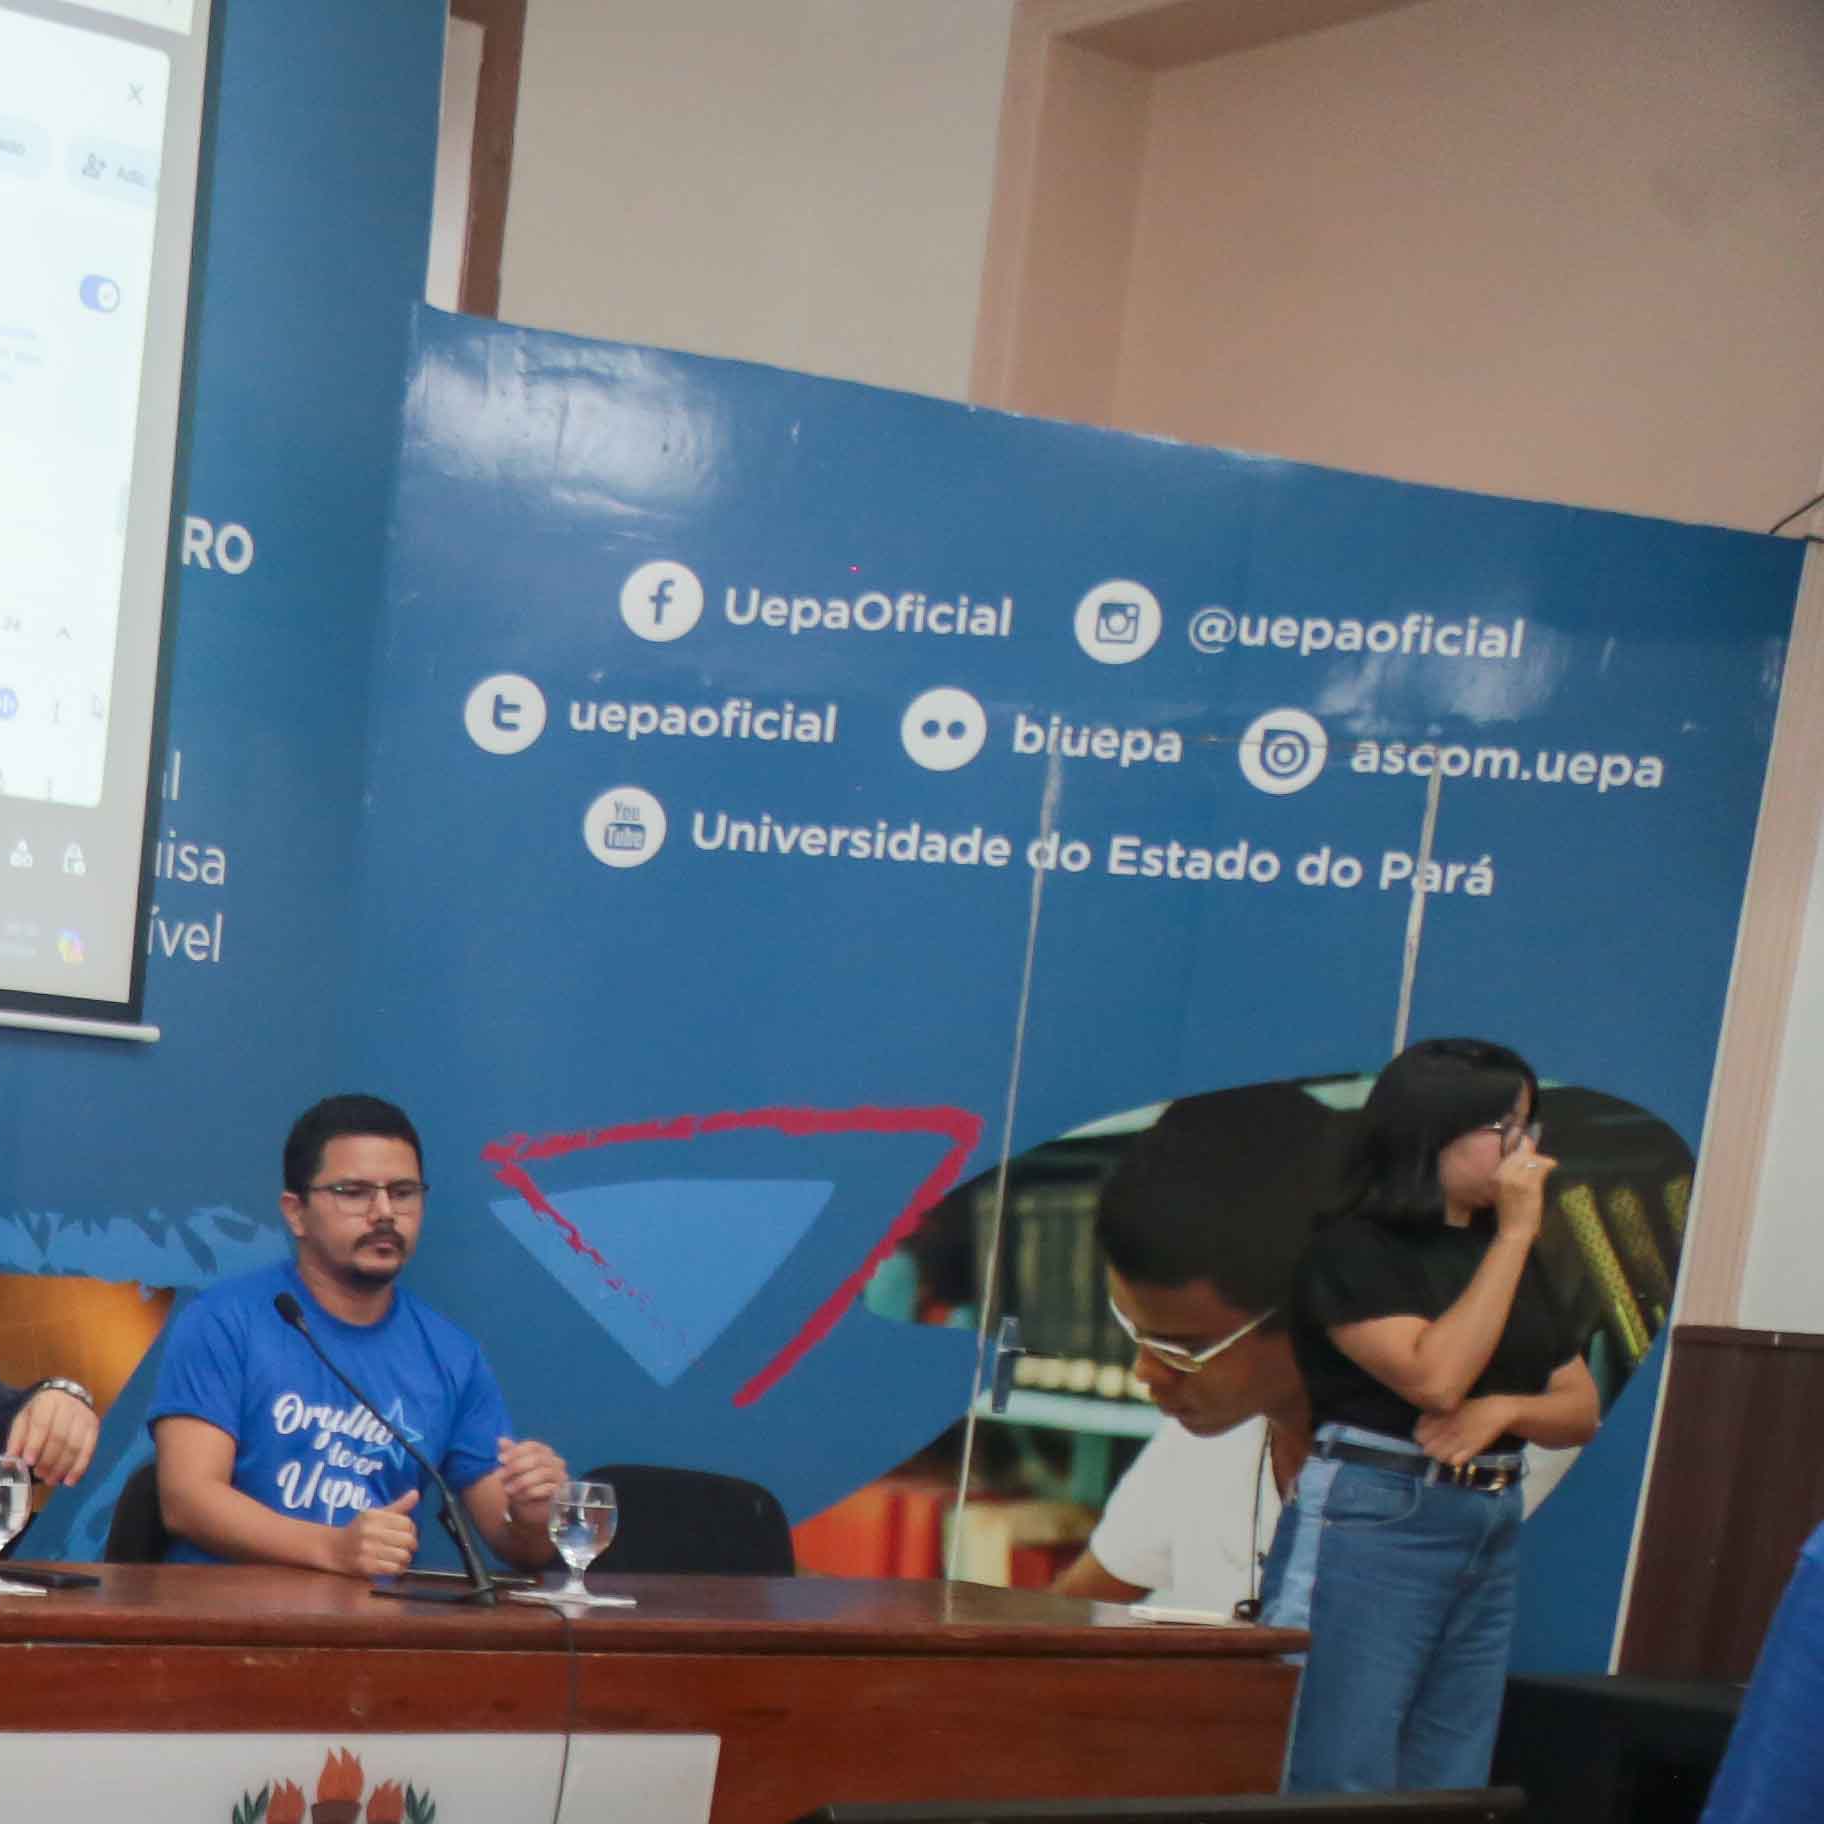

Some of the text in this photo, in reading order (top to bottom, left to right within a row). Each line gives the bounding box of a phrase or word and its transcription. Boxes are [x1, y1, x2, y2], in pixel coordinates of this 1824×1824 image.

[181, 514, 254, 575] RO
[723, 586, 1012, 638] UepaOficial
[1188, 604, 1526, 660] @uepaoficial
[568, 699, 838, 744] uepaoficial
[1013, 714, 1183, 768] biuepa
[1351, 739, 1664, 793] ascom.uepa
[691, 813, 1495, 896] Universidade do Estado do Pará
